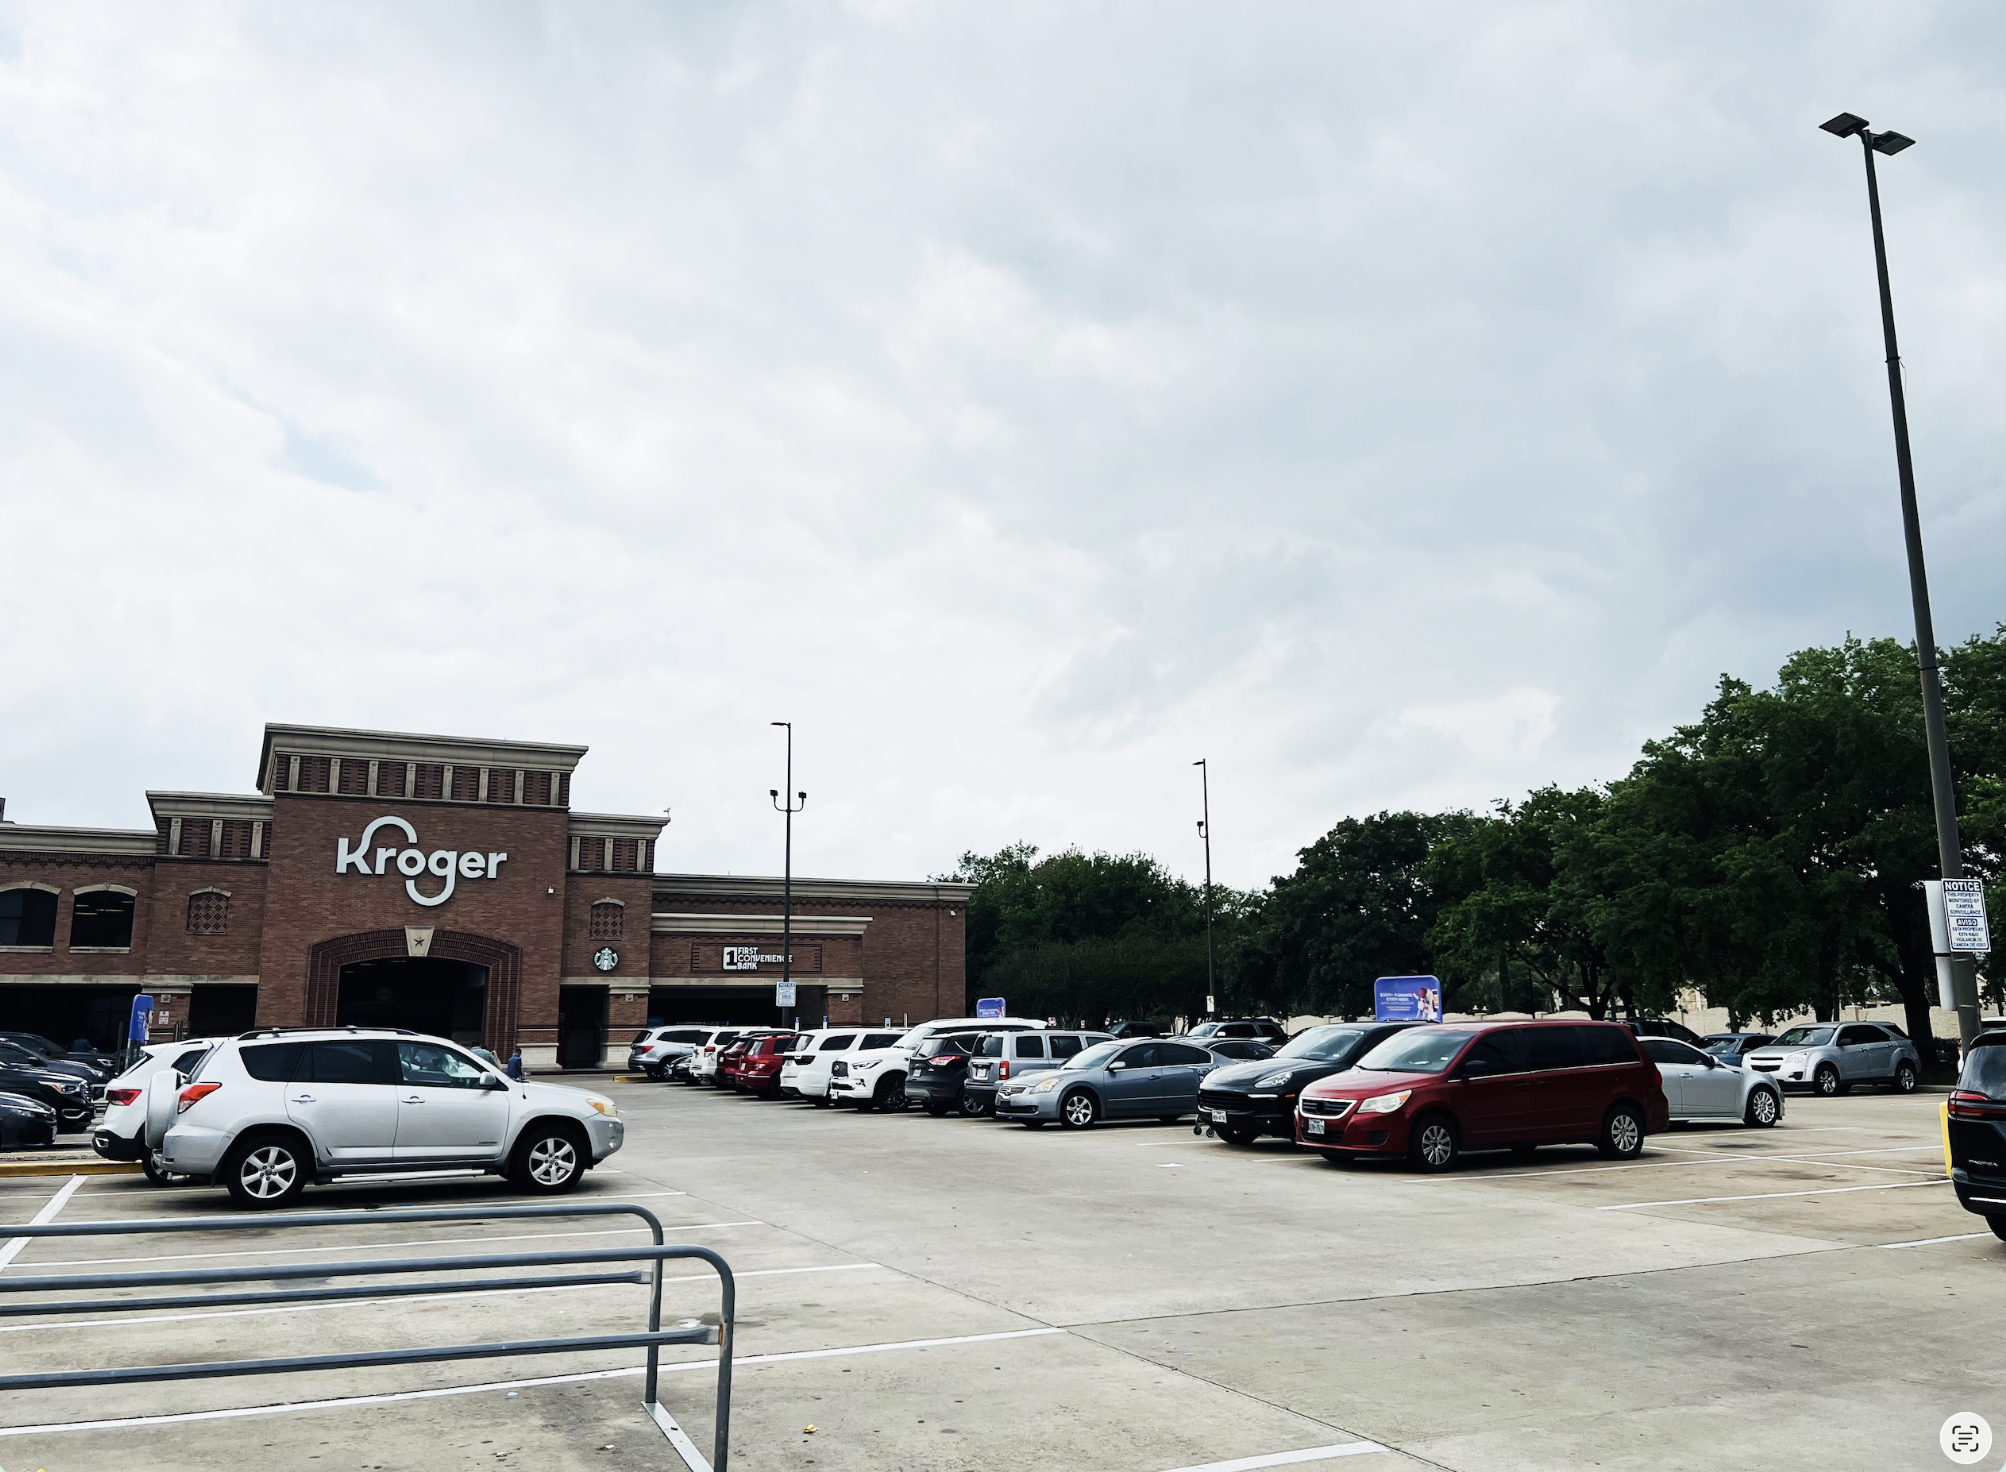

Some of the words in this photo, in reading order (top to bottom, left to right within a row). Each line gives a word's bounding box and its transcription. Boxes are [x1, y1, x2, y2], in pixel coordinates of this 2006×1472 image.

[336, 815, 508, 907] Kroger
[1944, 881, 1980, 891] NOTICE
[738, 947, 758, 955] FIRST
[737, 962, 758, 970] BANK
[1968, 1159, 1998, 1167] PACIFICA
